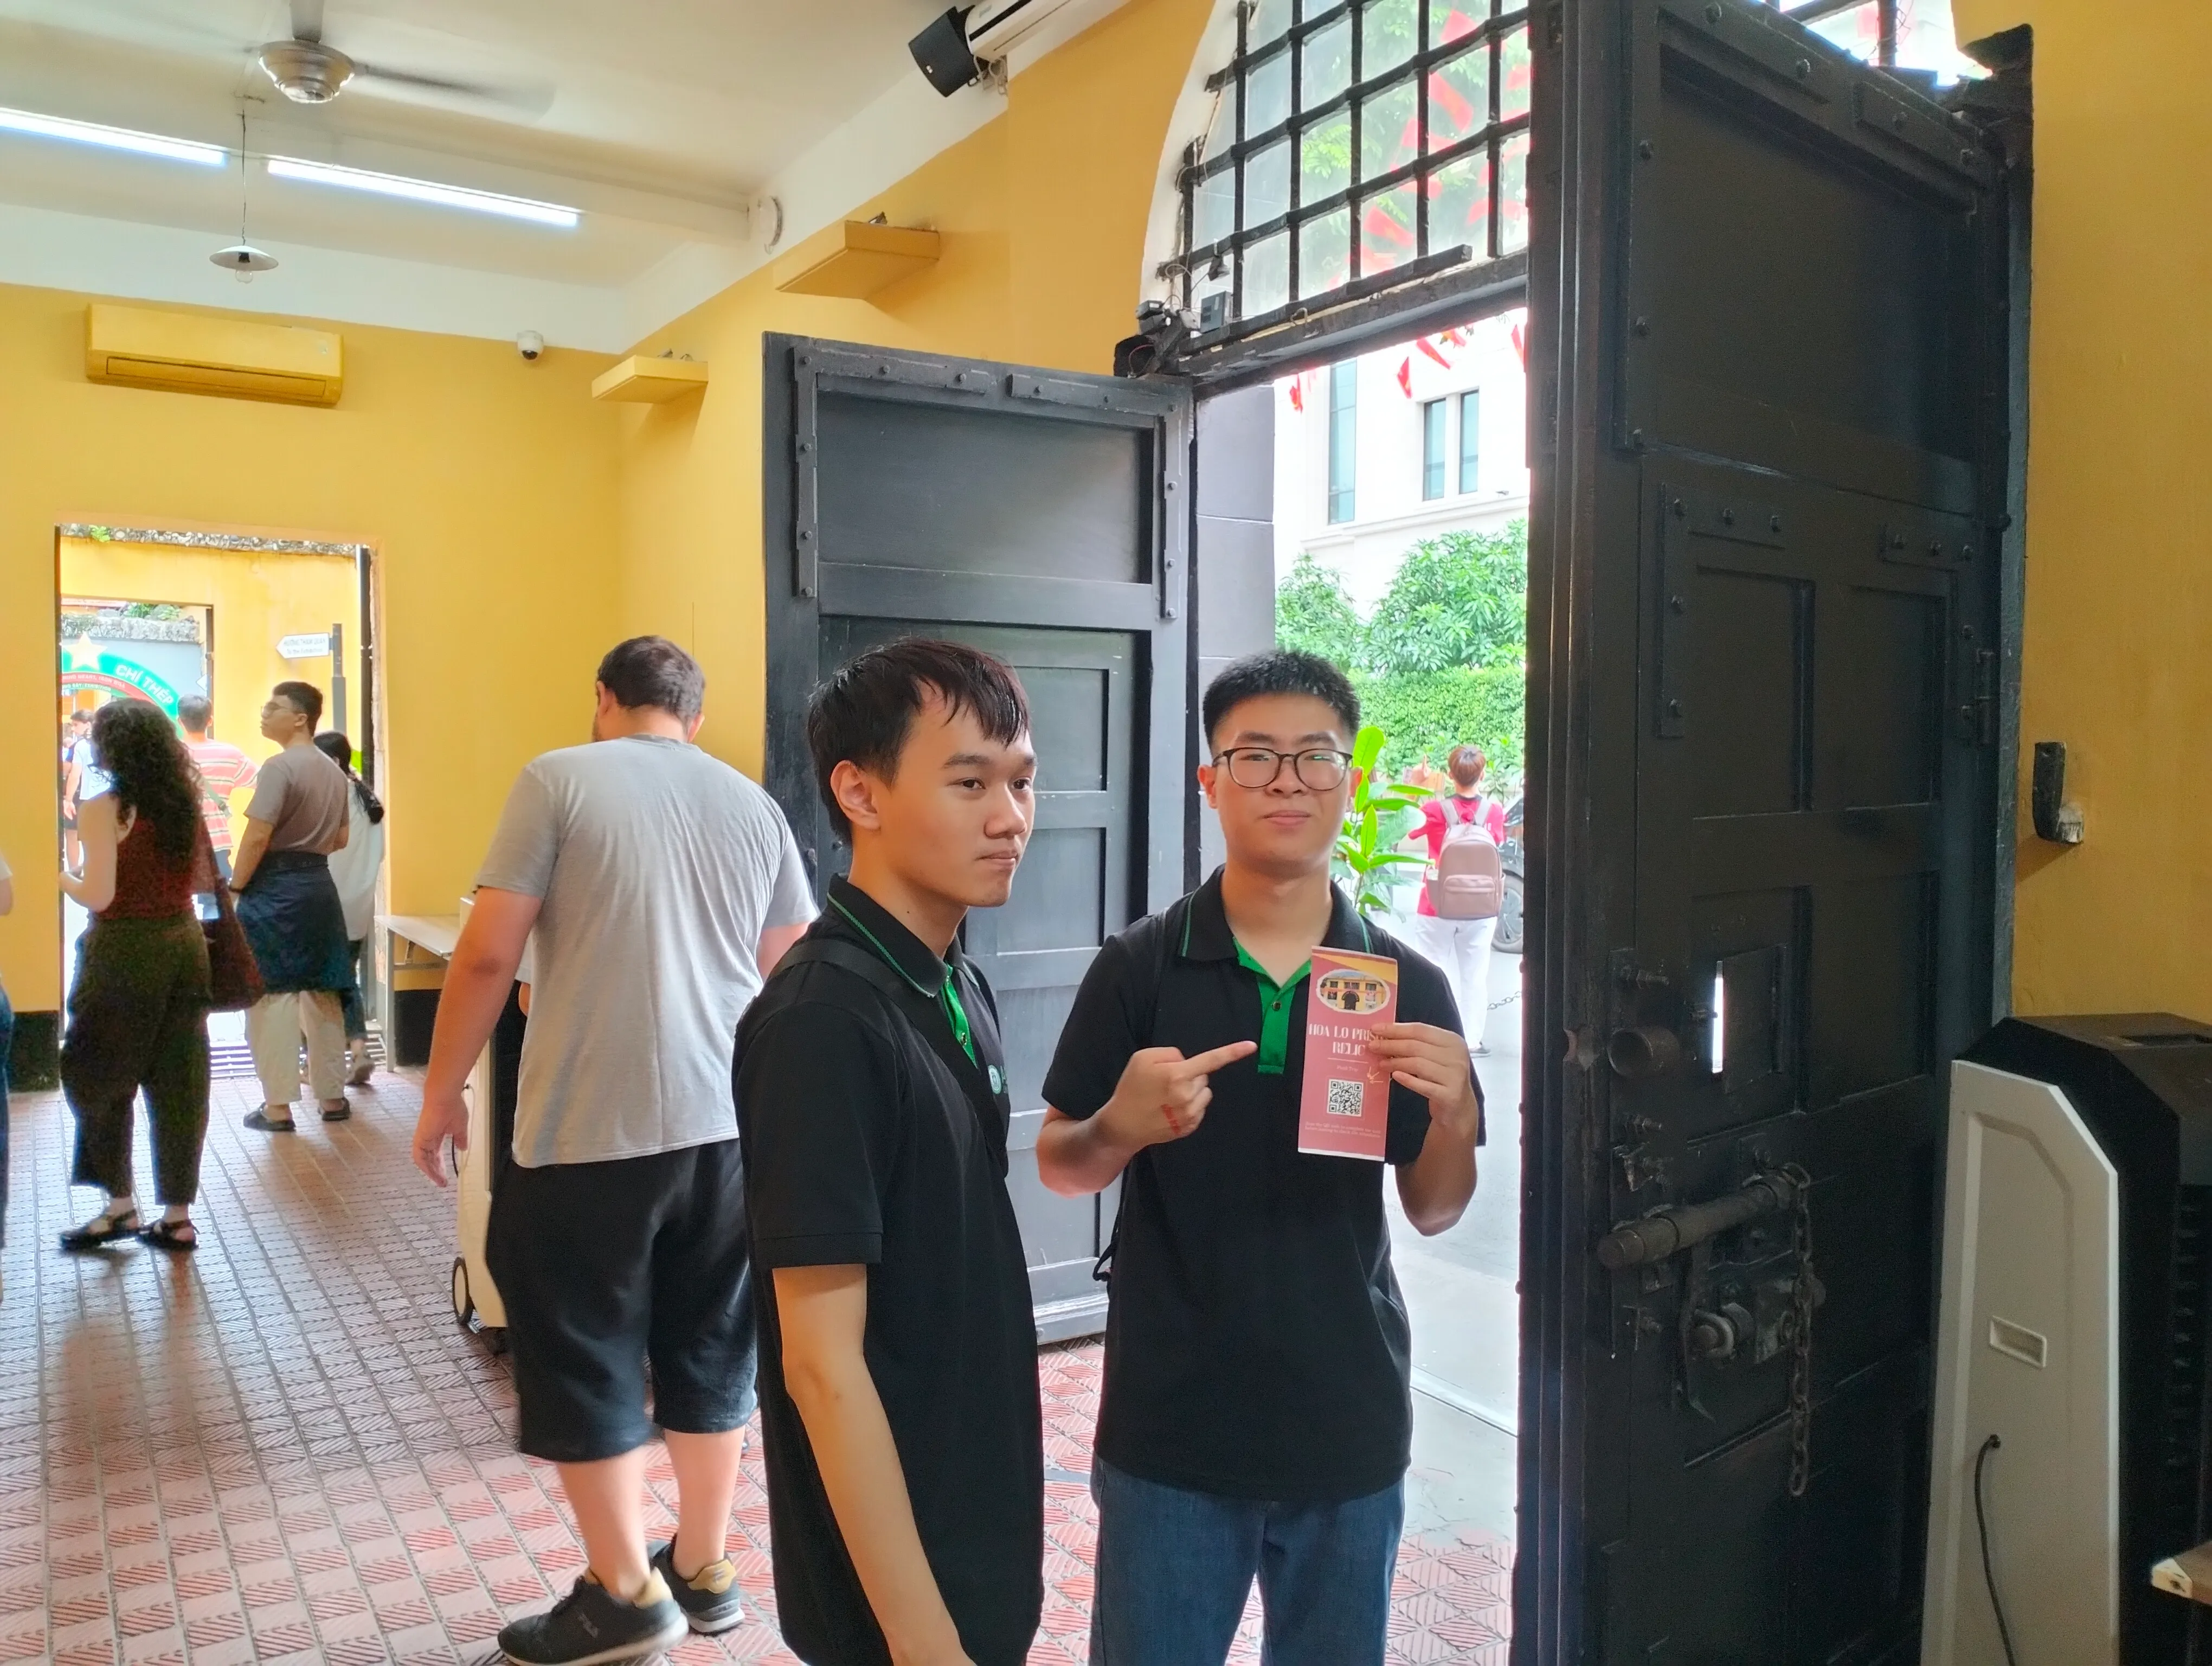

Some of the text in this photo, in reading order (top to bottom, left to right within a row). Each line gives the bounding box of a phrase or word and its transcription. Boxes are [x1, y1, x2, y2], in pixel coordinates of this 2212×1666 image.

[115, 664, 173, 703] CHÍ THÉP
[1309, 1023, 1380, 1041] HOA LO PRIS
[1333, 1041, 1365, 1056] RELIC
